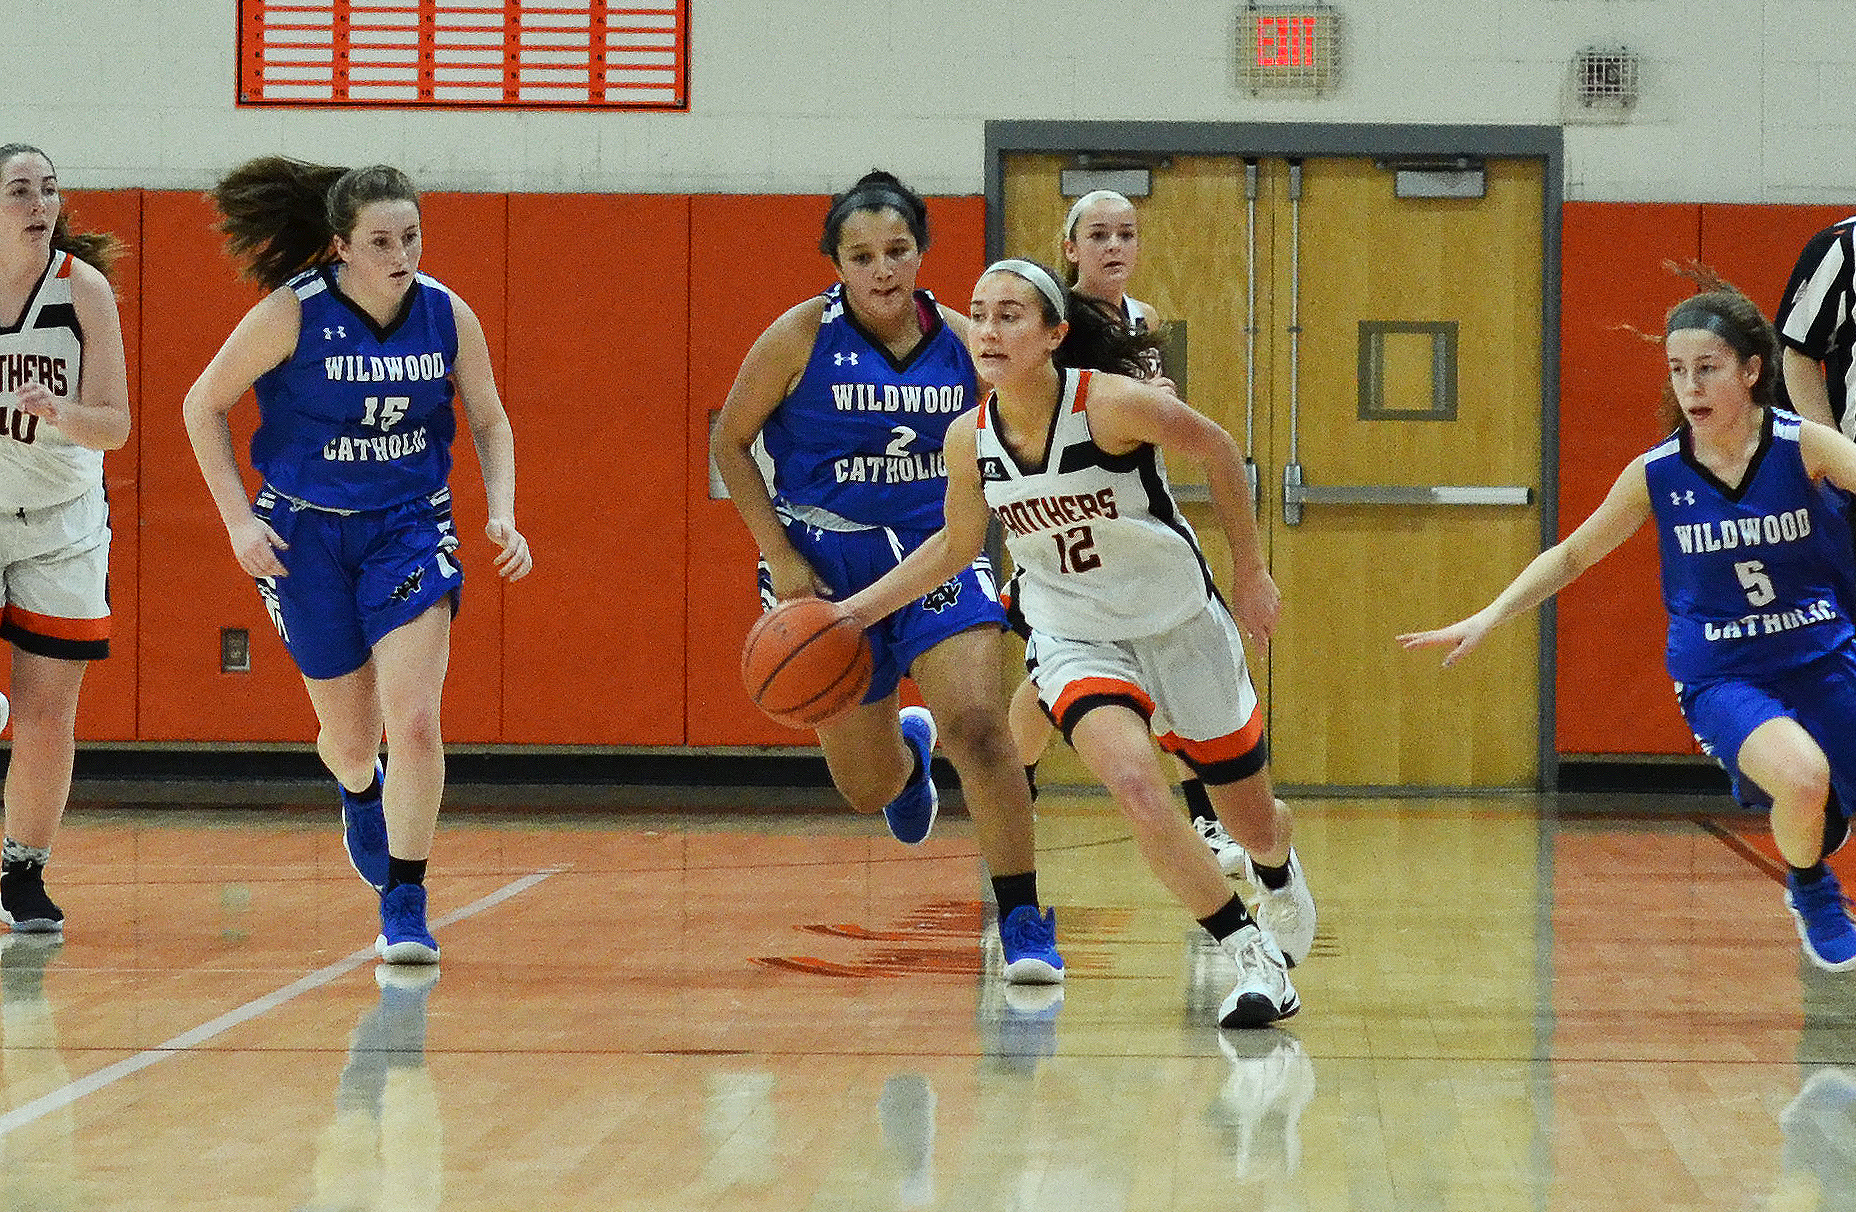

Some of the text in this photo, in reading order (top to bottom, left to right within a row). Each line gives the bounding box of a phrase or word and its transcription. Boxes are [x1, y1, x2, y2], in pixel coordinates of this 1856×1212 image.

[1257, 17, 1316, 66] EXIT
[325, 352, 445, 382] WILDWOOD
[361, 397, 410, 432] 15
[831, 384, 964, 413] WILDWOOD
[323, 426, 427, 461] CATHOLIC
[885, 425, 917, 457] 2
[991, 487, 1119, 538] ANTHERS
[1674, 508, 1811, 554] WILDWOOD
[1052, 525, 1102, 574] 12
[1734, 560, 1776, 607] 5
[1704, 599, 1837, 641] CATHOLIC
